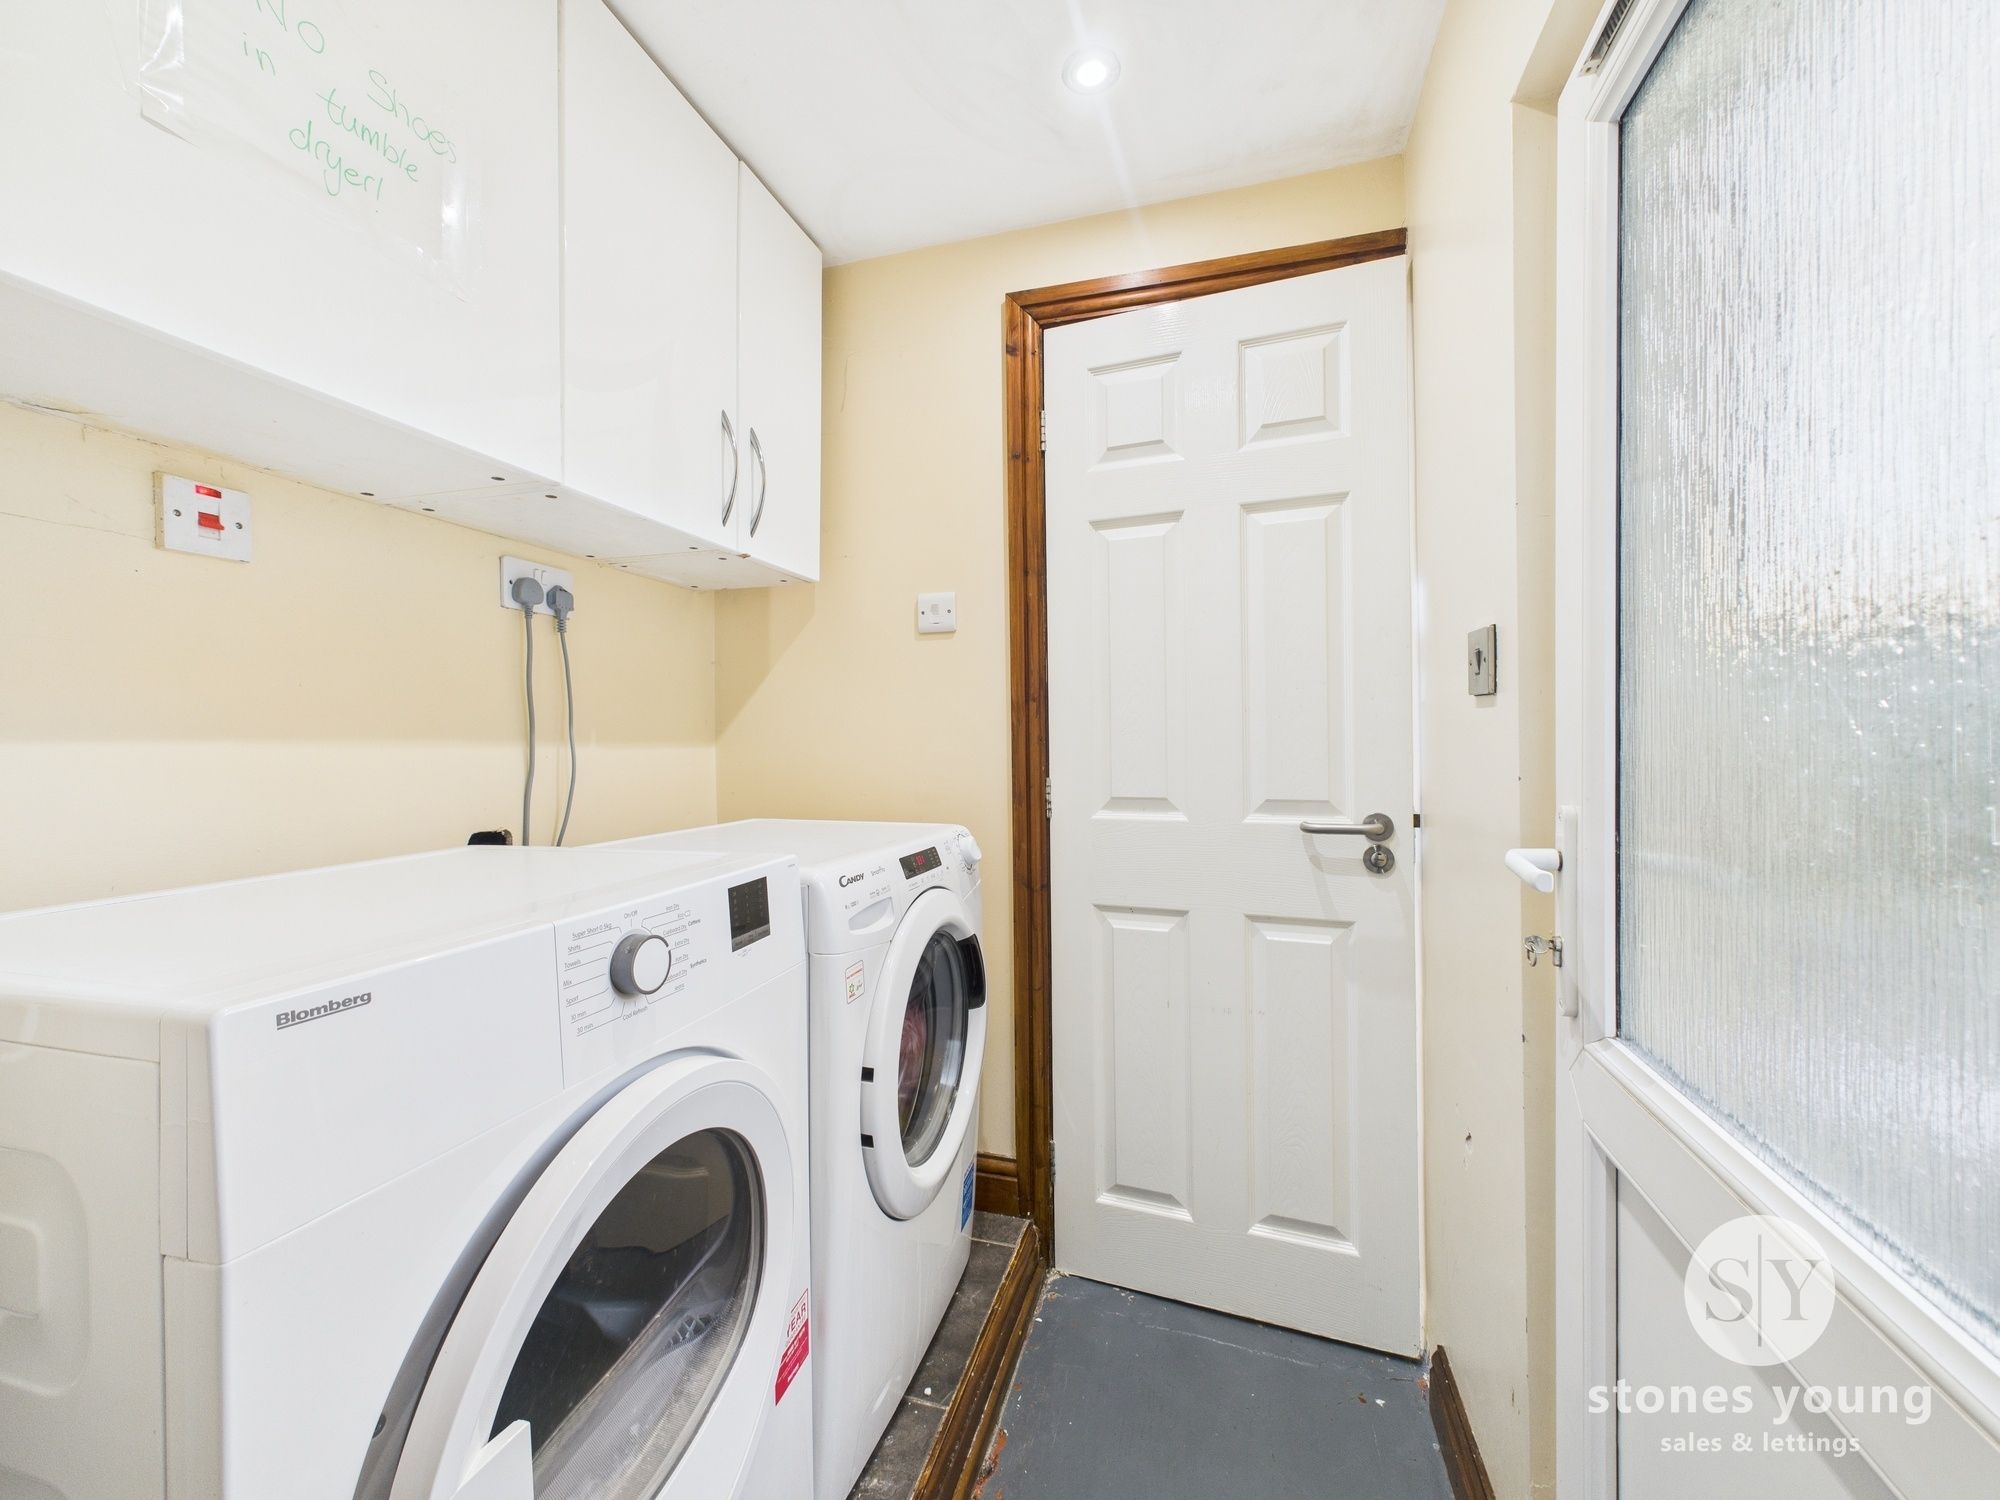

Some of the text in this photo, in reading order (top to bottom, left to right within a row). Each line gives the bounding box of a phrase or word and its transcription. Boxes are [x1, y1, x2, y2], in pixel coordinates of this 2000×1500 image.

[242, 31, 419, 183] in tumble
[562, 978, 573, 987] Mix
[276, 992, 372, 1030] Blomberg
